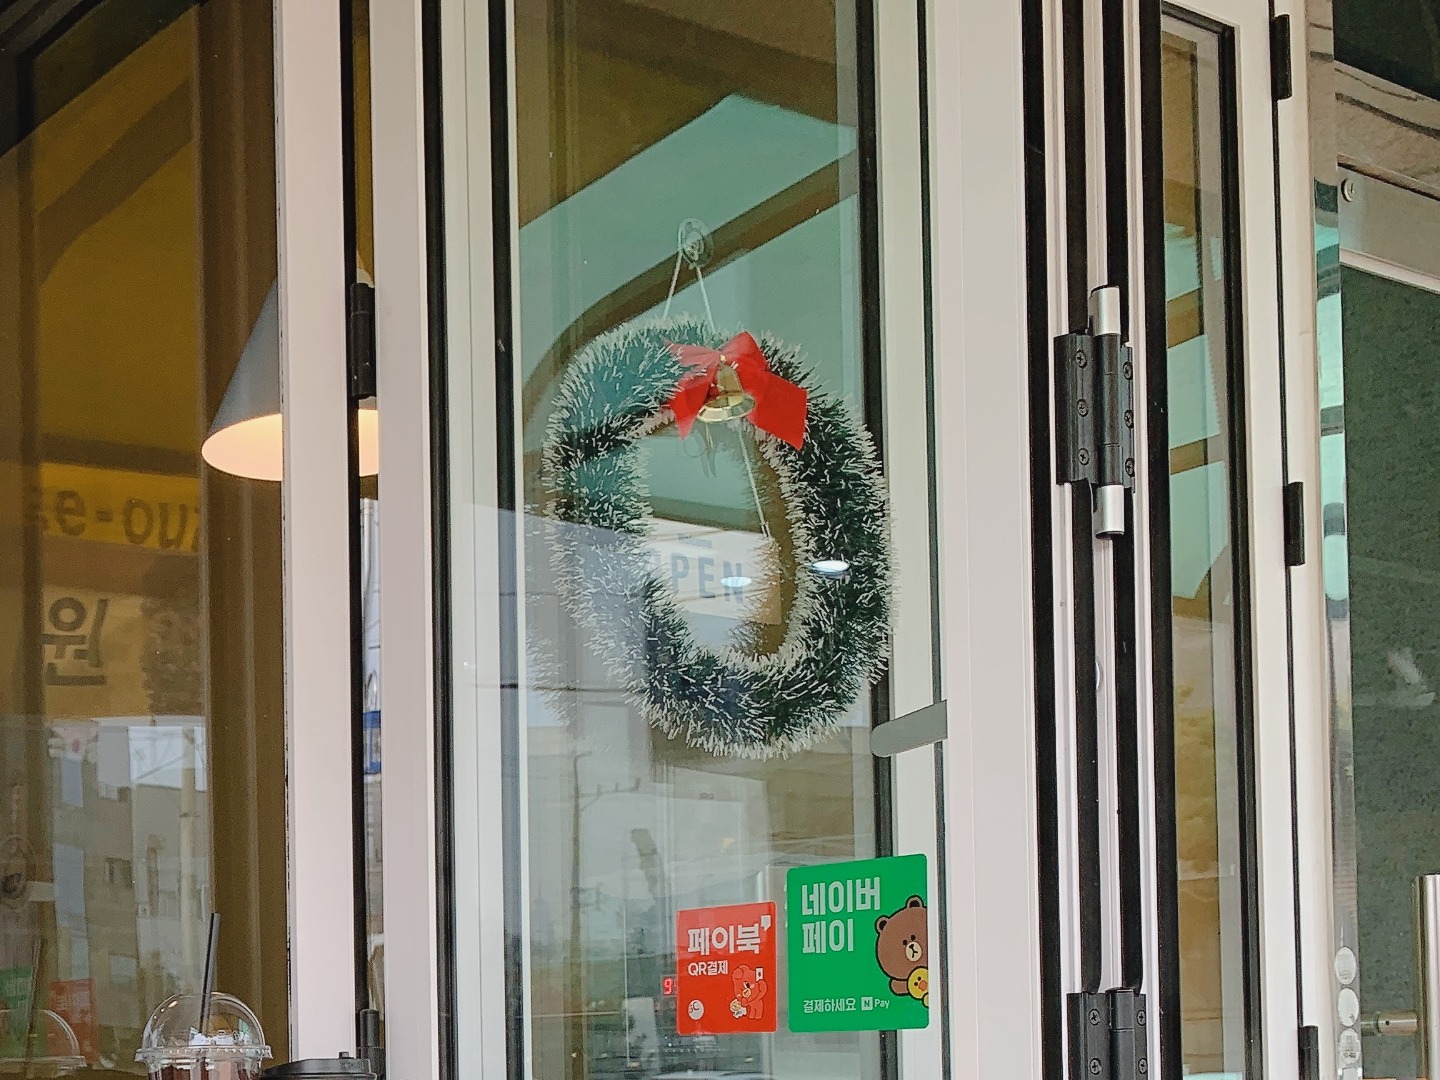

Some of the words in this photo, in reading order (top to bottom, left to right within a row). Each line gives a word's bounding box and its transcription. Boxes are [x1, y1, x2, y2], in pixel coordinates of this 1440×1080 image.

[801, 876, 881, 916] 네이버
[687, 922, 760, 956] 페이북
[801, 918, 854, 954] 페이
[687, 959, 728, 977] QR결제
[803, 997, 857, 1014] 결제하세요
[874, 998, 890, 1010] Pay
